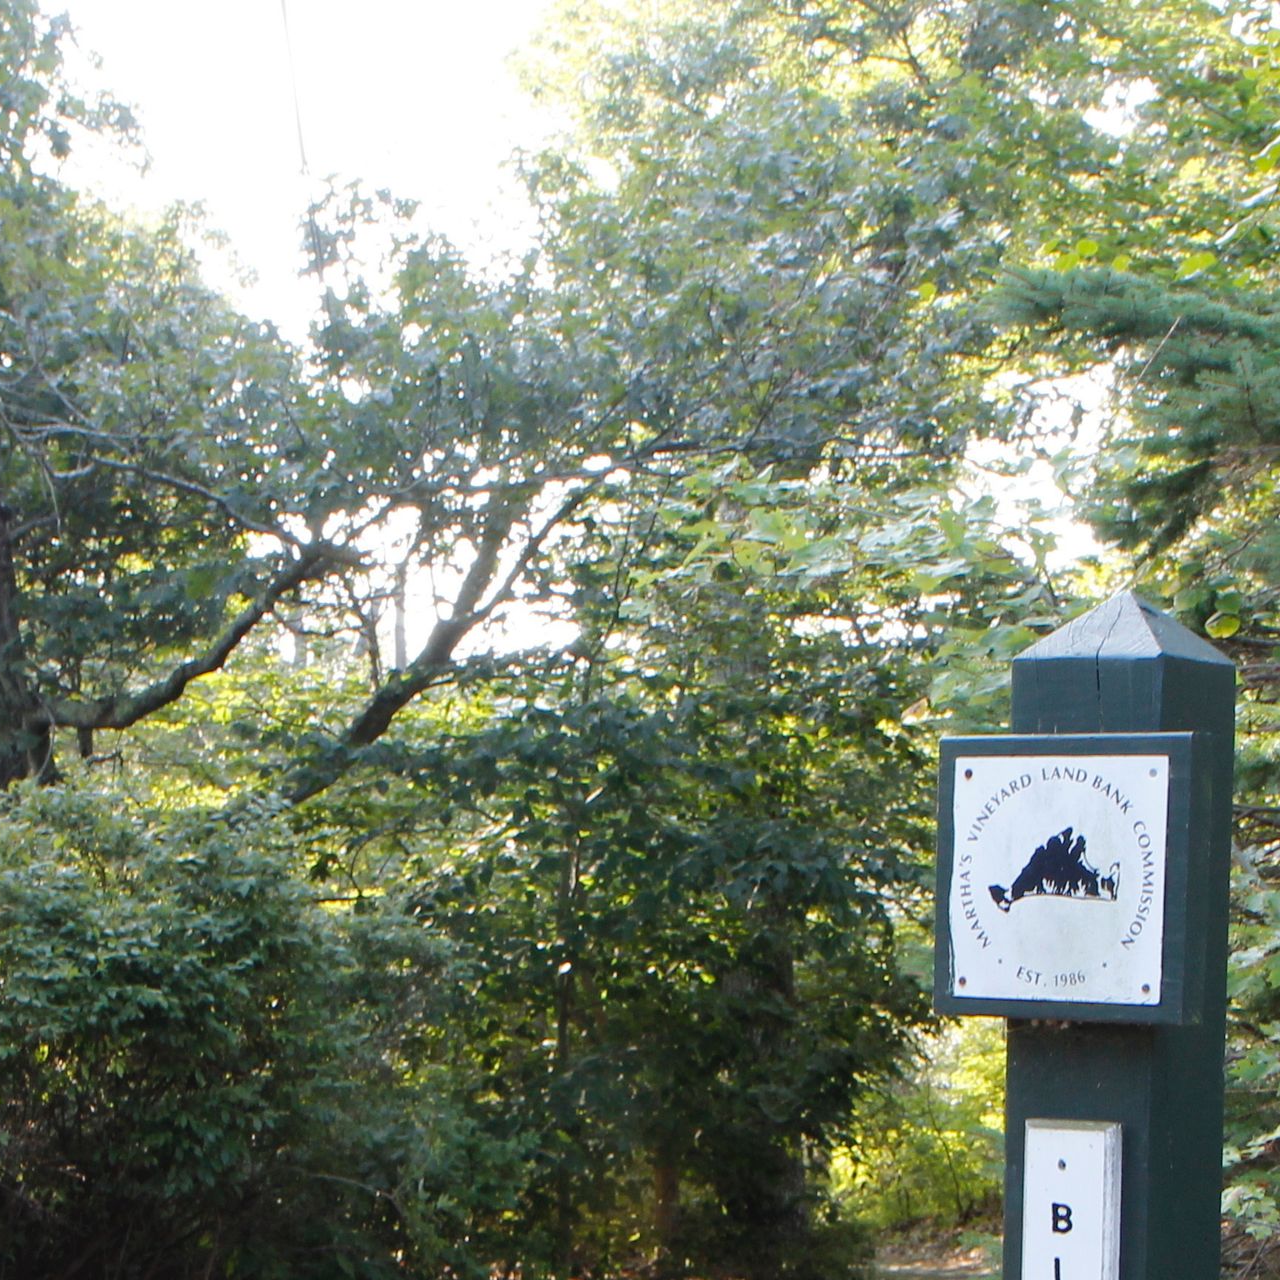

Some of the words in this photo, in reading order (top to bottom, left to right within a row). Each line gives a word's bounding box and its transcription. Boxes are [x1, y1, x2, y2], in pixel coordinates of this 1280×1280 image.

[1041, 767, 1087, 784] LAND
[1092, 777, 1134, 815] BANK
[967, 773, 1032, 844] VINEYARD
[960, 855, 992, 949] MARTHA'S
[1121, 820, 1156, 951] COMMISSION
[1016, 966, 1047, 987] EST.
[1054, 970, 1086, 988] 1986
